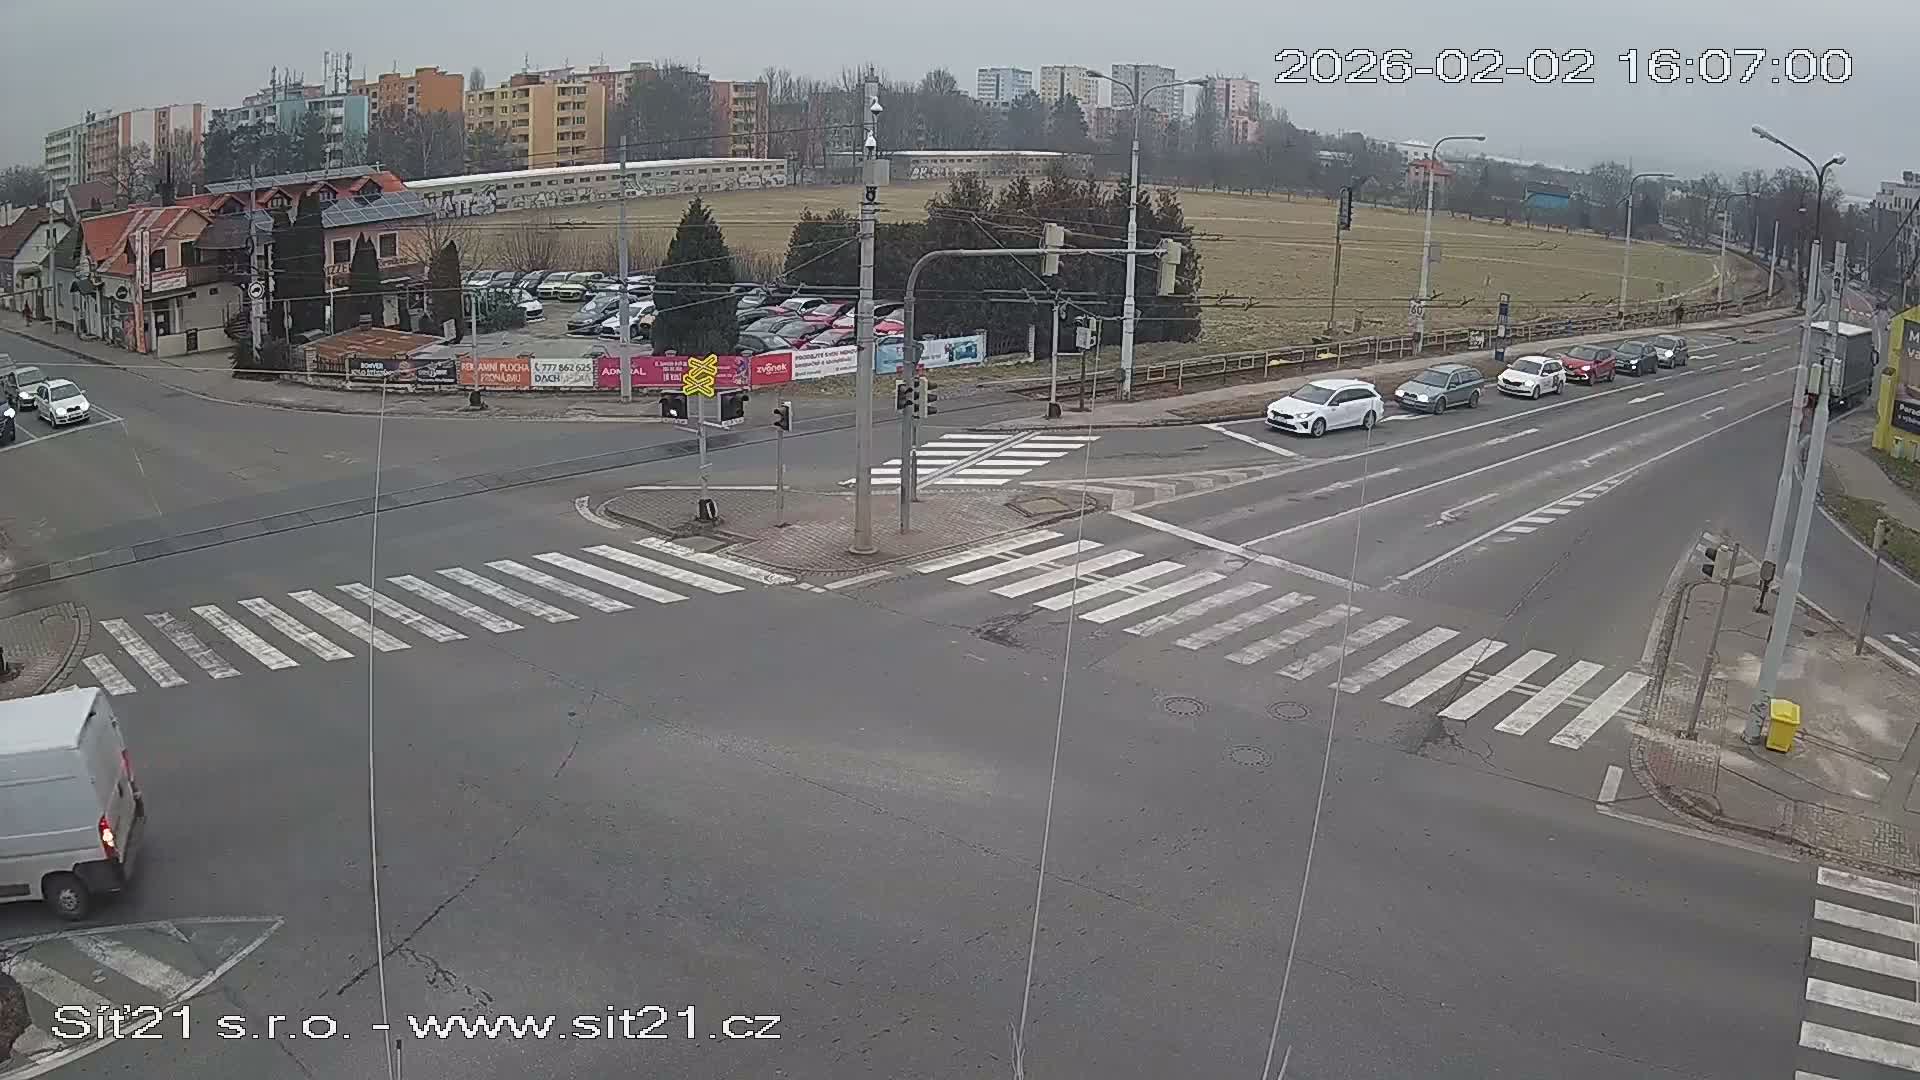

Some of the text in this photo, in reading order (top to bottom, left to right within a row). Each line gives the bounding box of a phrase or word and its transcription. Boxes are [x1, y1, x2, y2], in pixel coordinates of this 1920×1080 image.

[1411, 303, 1423, 316] 60
[542, 363, 591, 371] 777 862 625
